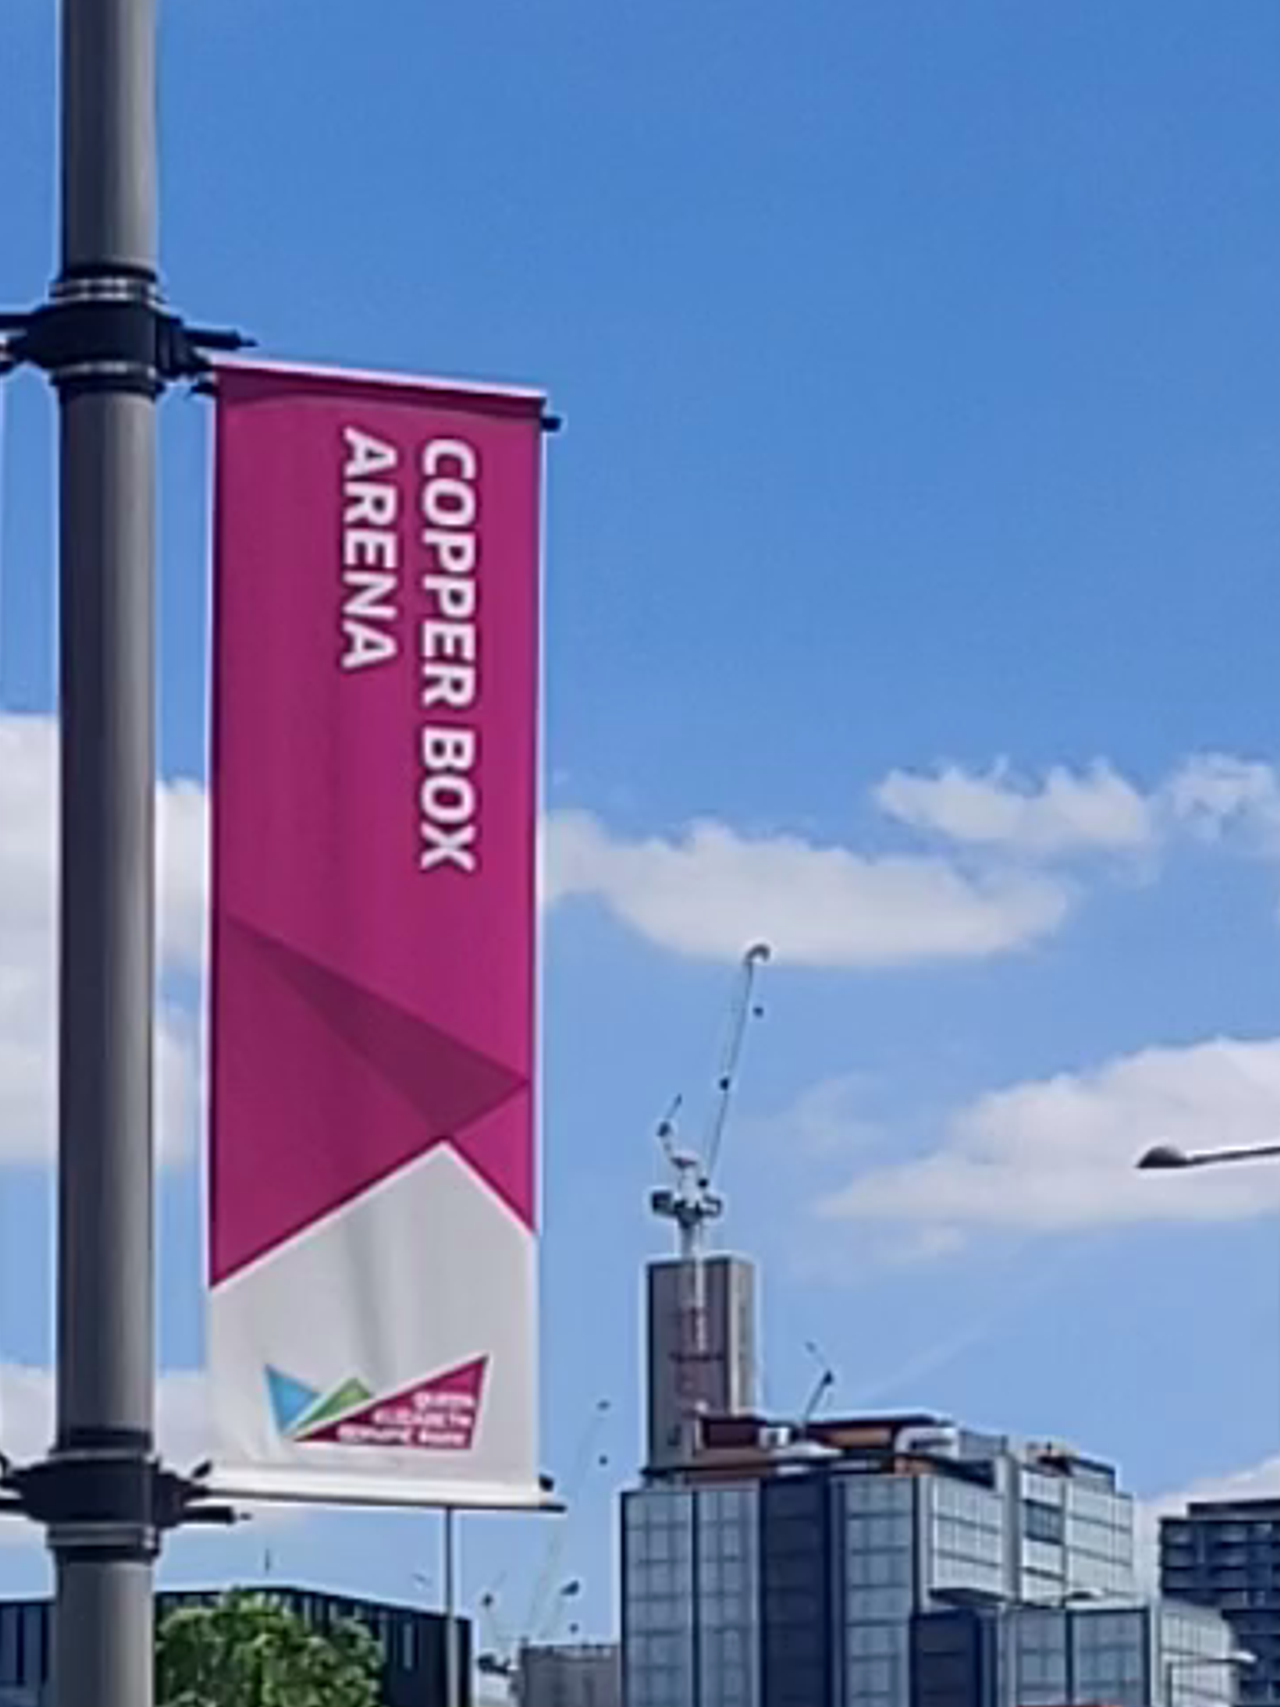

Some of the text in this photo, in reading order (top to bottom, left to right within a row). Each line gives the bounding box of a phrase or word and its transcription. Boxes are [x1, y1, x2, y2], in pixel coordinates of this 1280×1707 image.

[343, 428, 398, 668] ARENA
[422, 440, 475, 871] COPPER BOX
